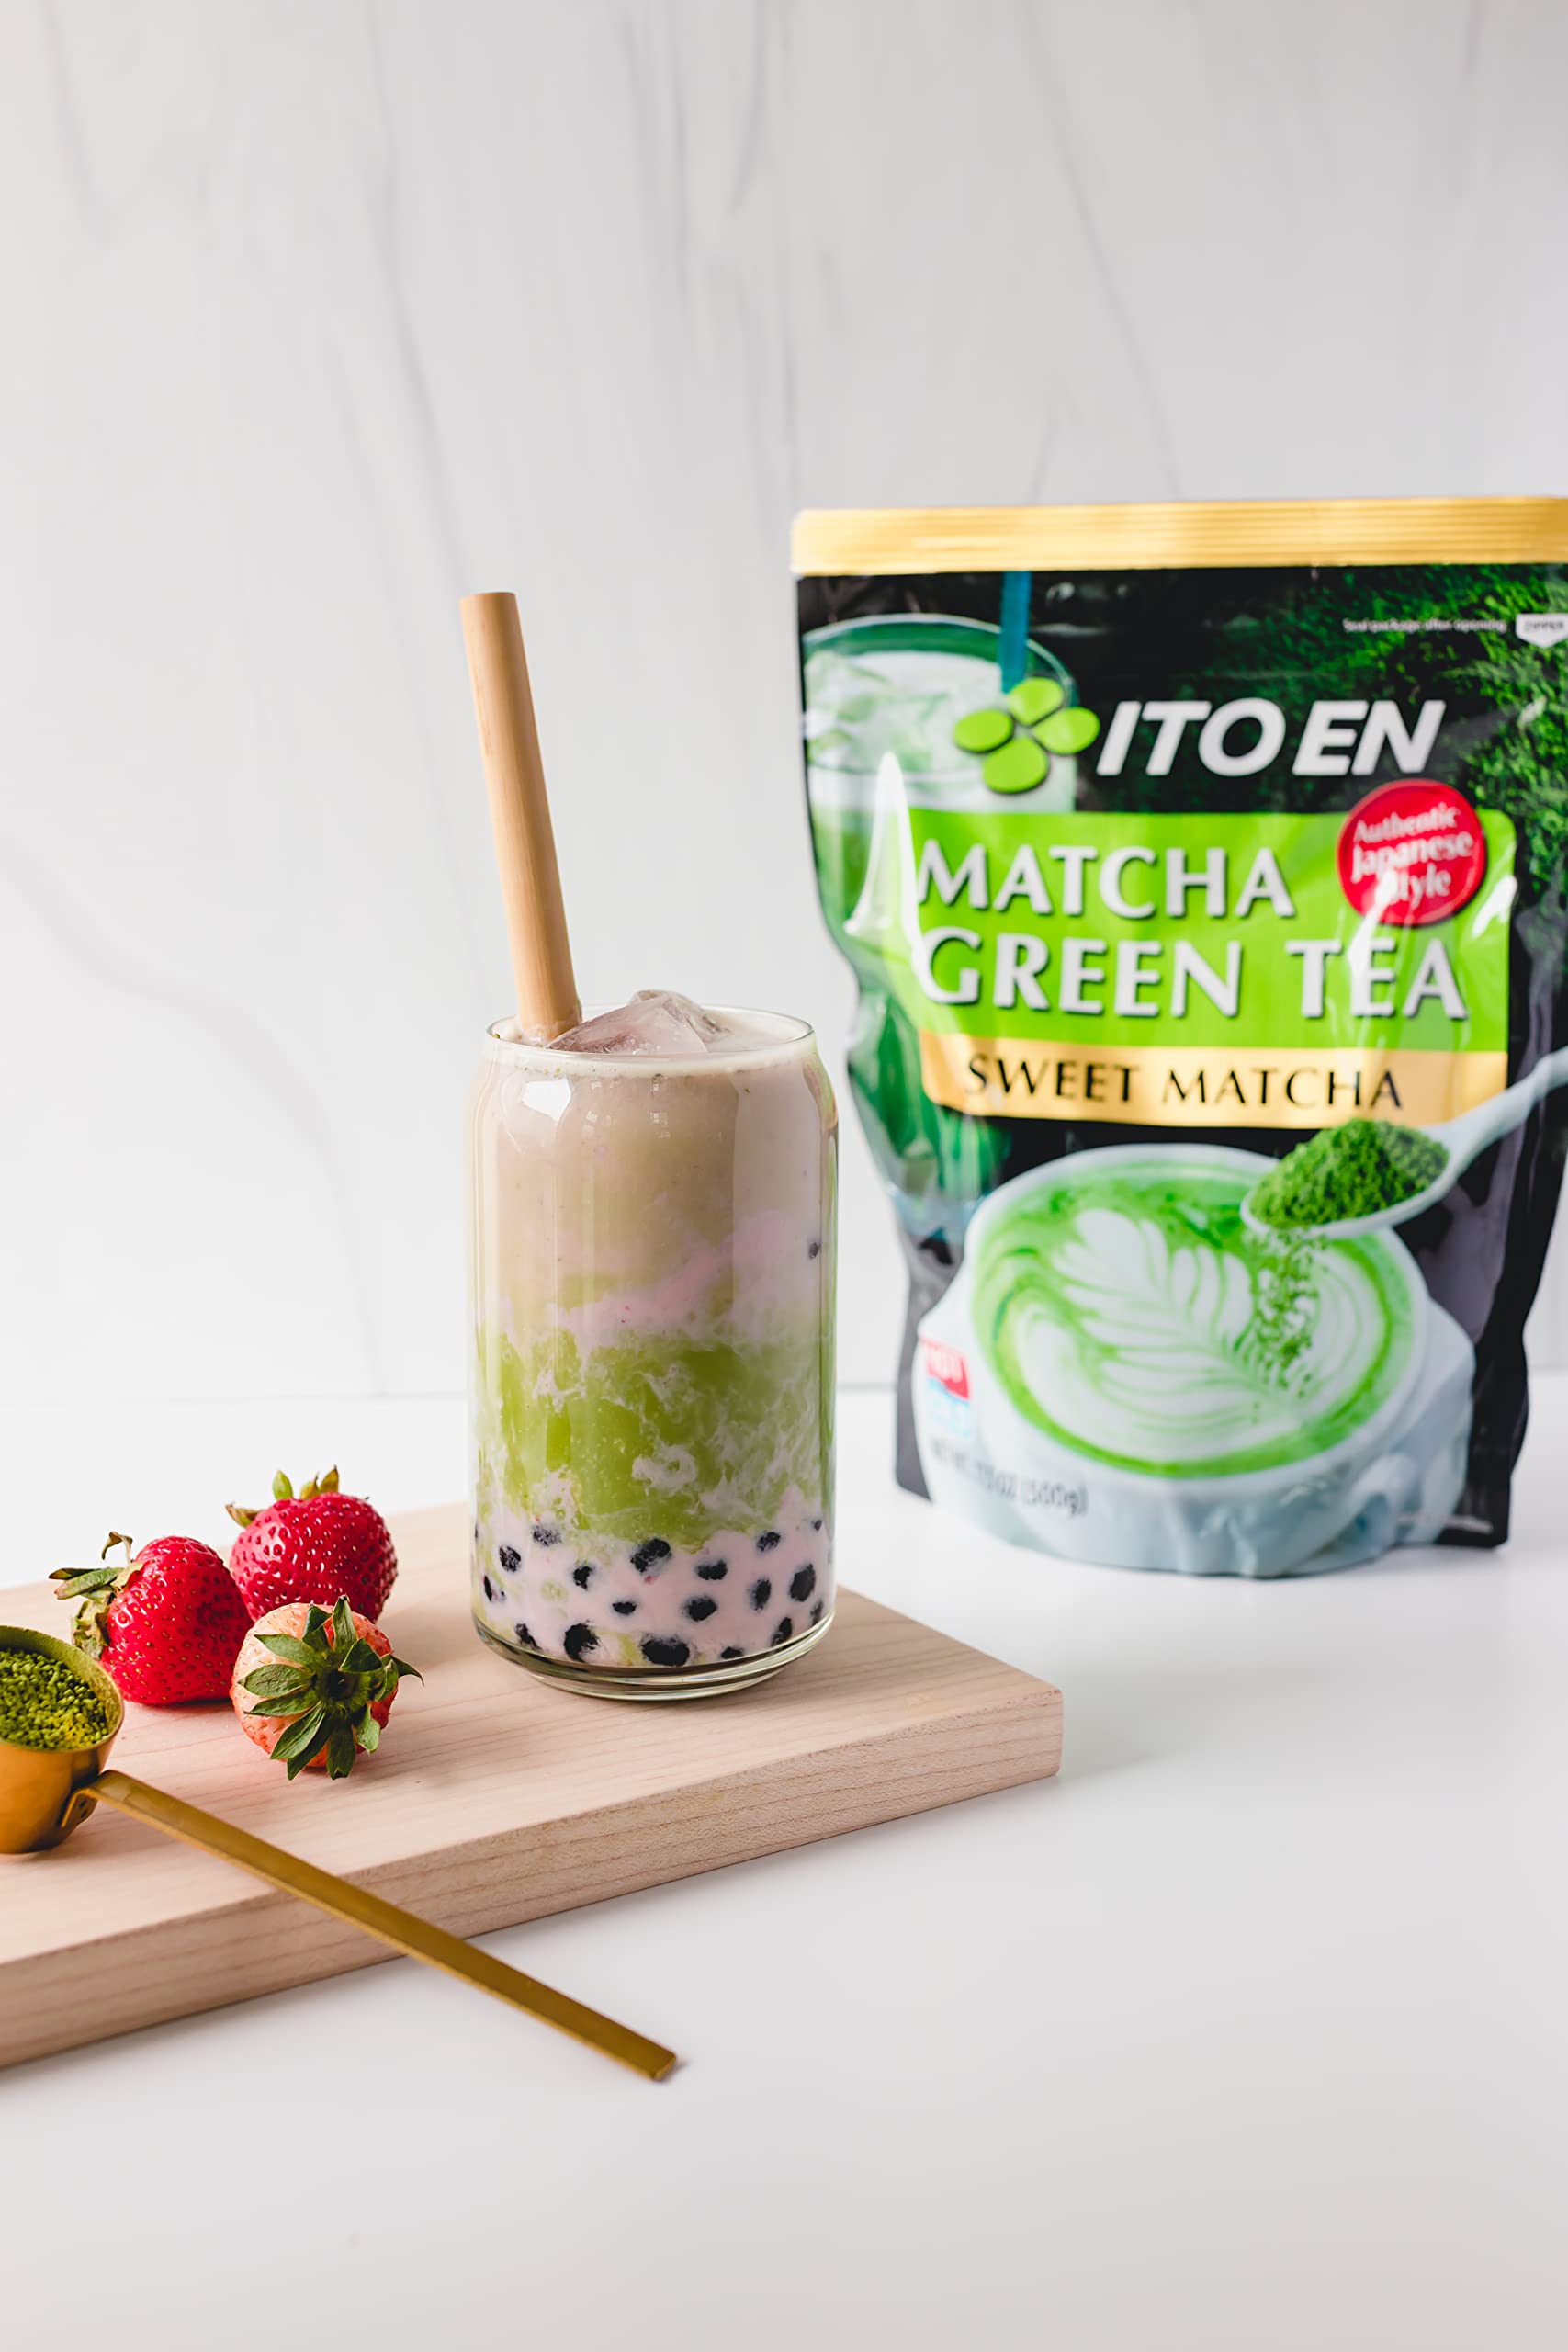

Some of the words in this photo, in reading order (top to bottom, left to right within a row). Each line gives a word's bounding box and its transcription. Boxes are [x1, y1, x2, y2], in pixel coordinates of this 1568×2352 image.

[1424, 618, 1452, 631] after
[1454, 619, 1507, 634] opening
[1096, 697, 1286, 776] ITO
[1292, 699, 1447, 776] EN
[1353, 801, 1461, 843] Authentic
[919, 839, 1296, 918] MATCHA
[1350, 831, 1474, 884] Japanese
[921, 927, 1242, 1017] GREEN
[1286, 940, 1469, 1019] TEA
[965, 1053, 1140, 1103] SWEET
[1162, 1067, 1403, 1109] MATCHA
